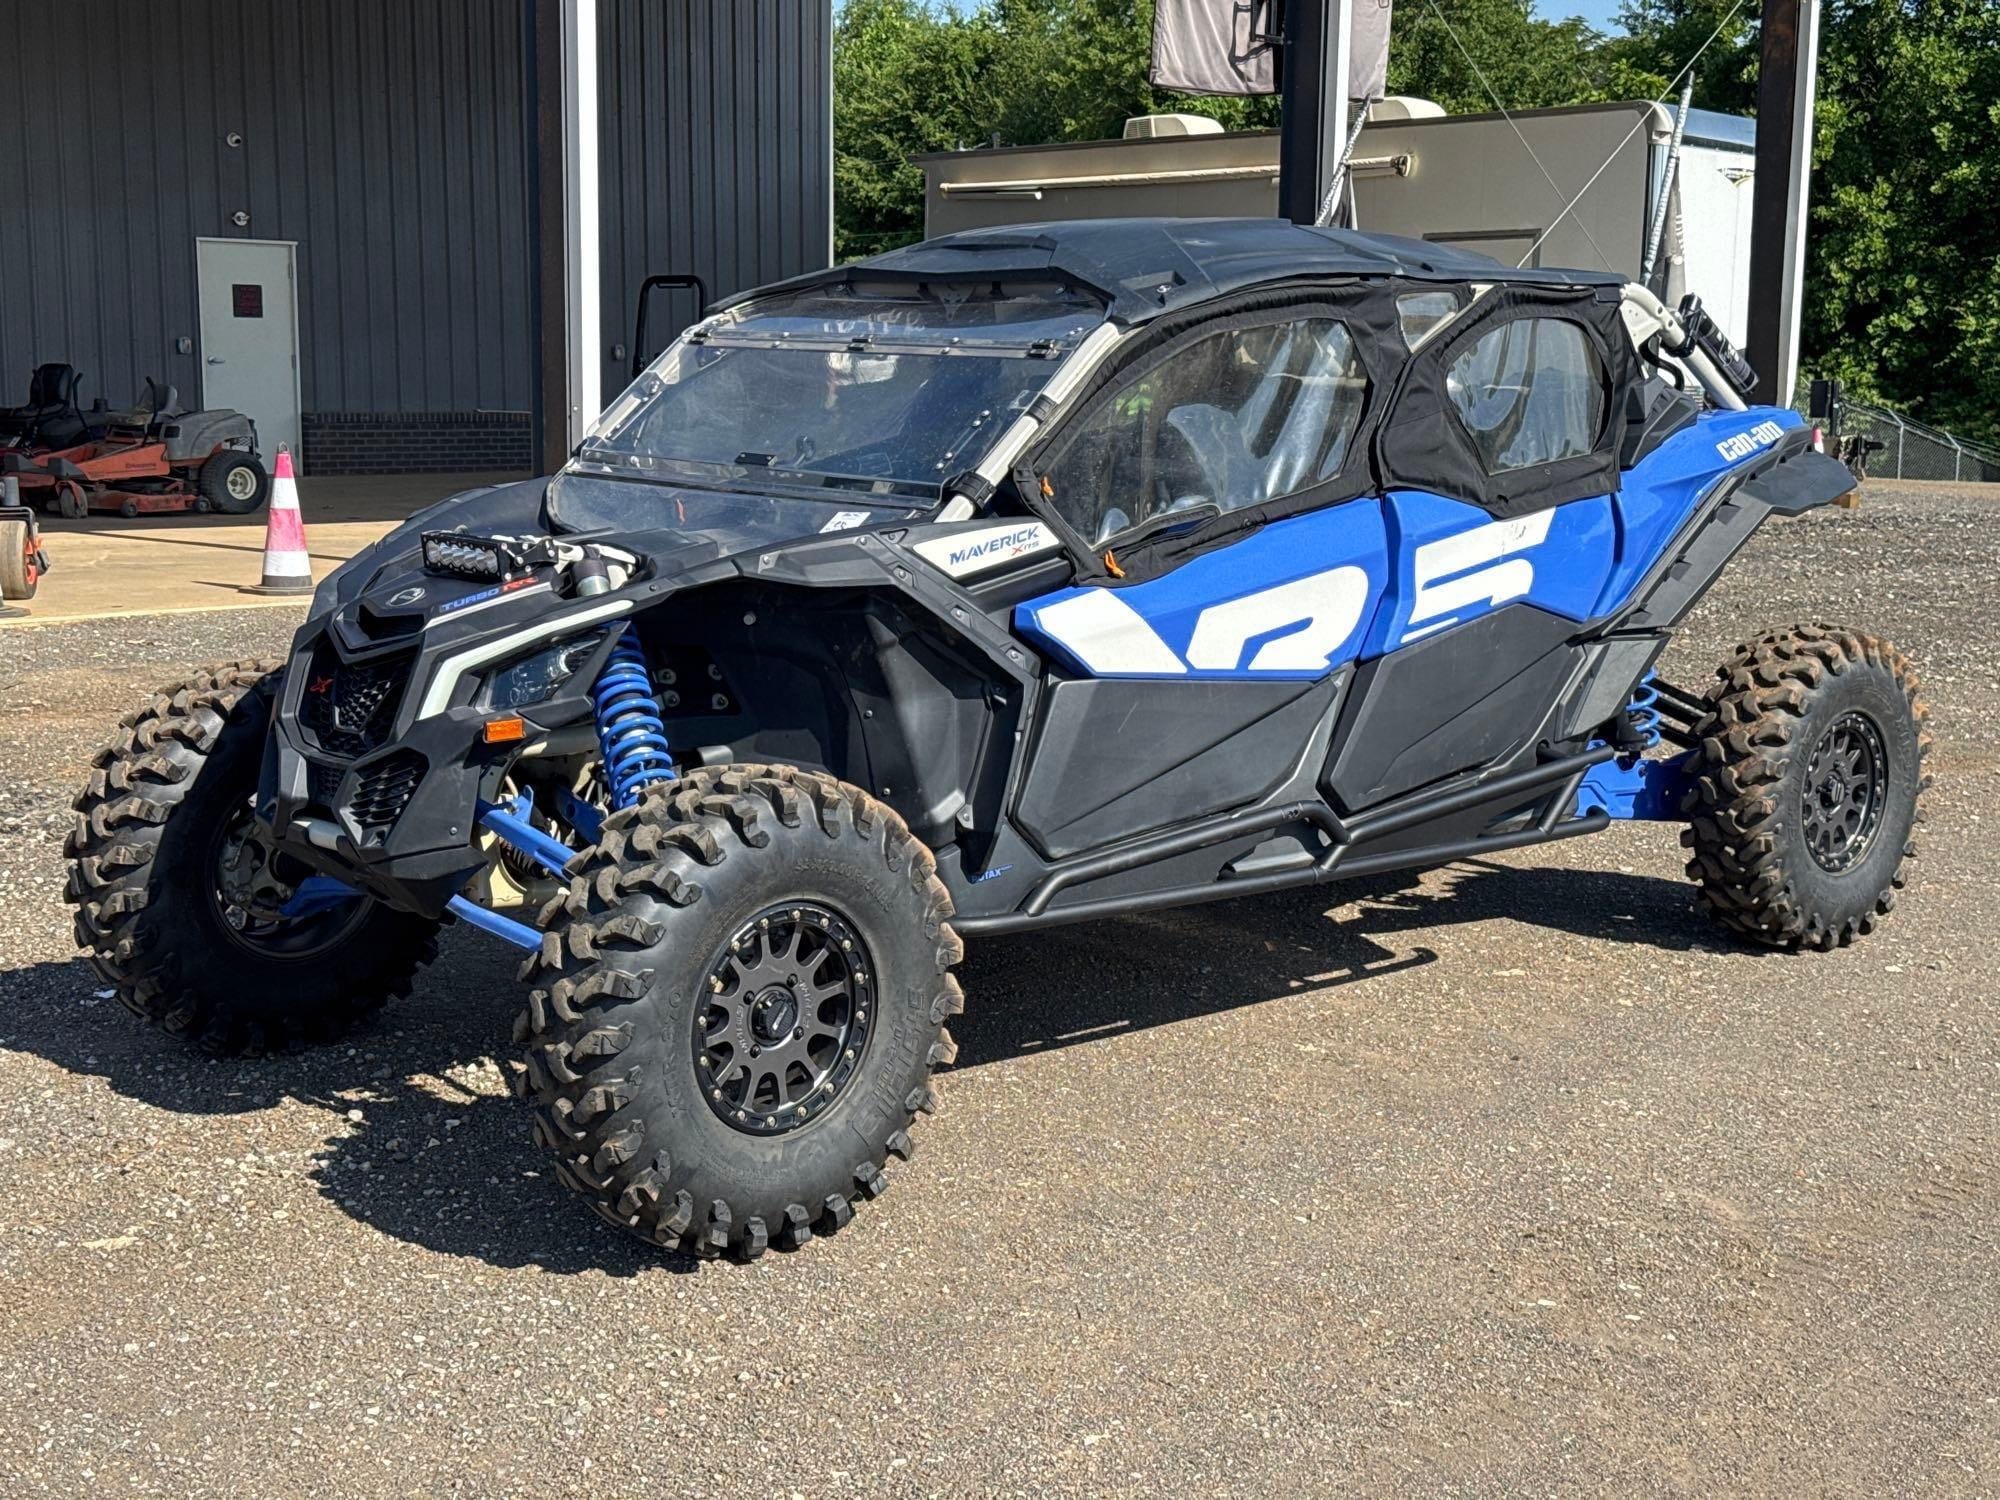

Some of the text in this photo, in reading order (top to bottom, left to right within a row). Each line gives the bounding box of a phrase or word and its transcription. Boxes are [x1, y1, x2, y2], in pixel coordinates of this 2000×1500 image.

[1715, 420, 1785, 462] can-am
[949, 525, 1040, 565] MAVERICK
[440, 587, 500, 613] TURBO
